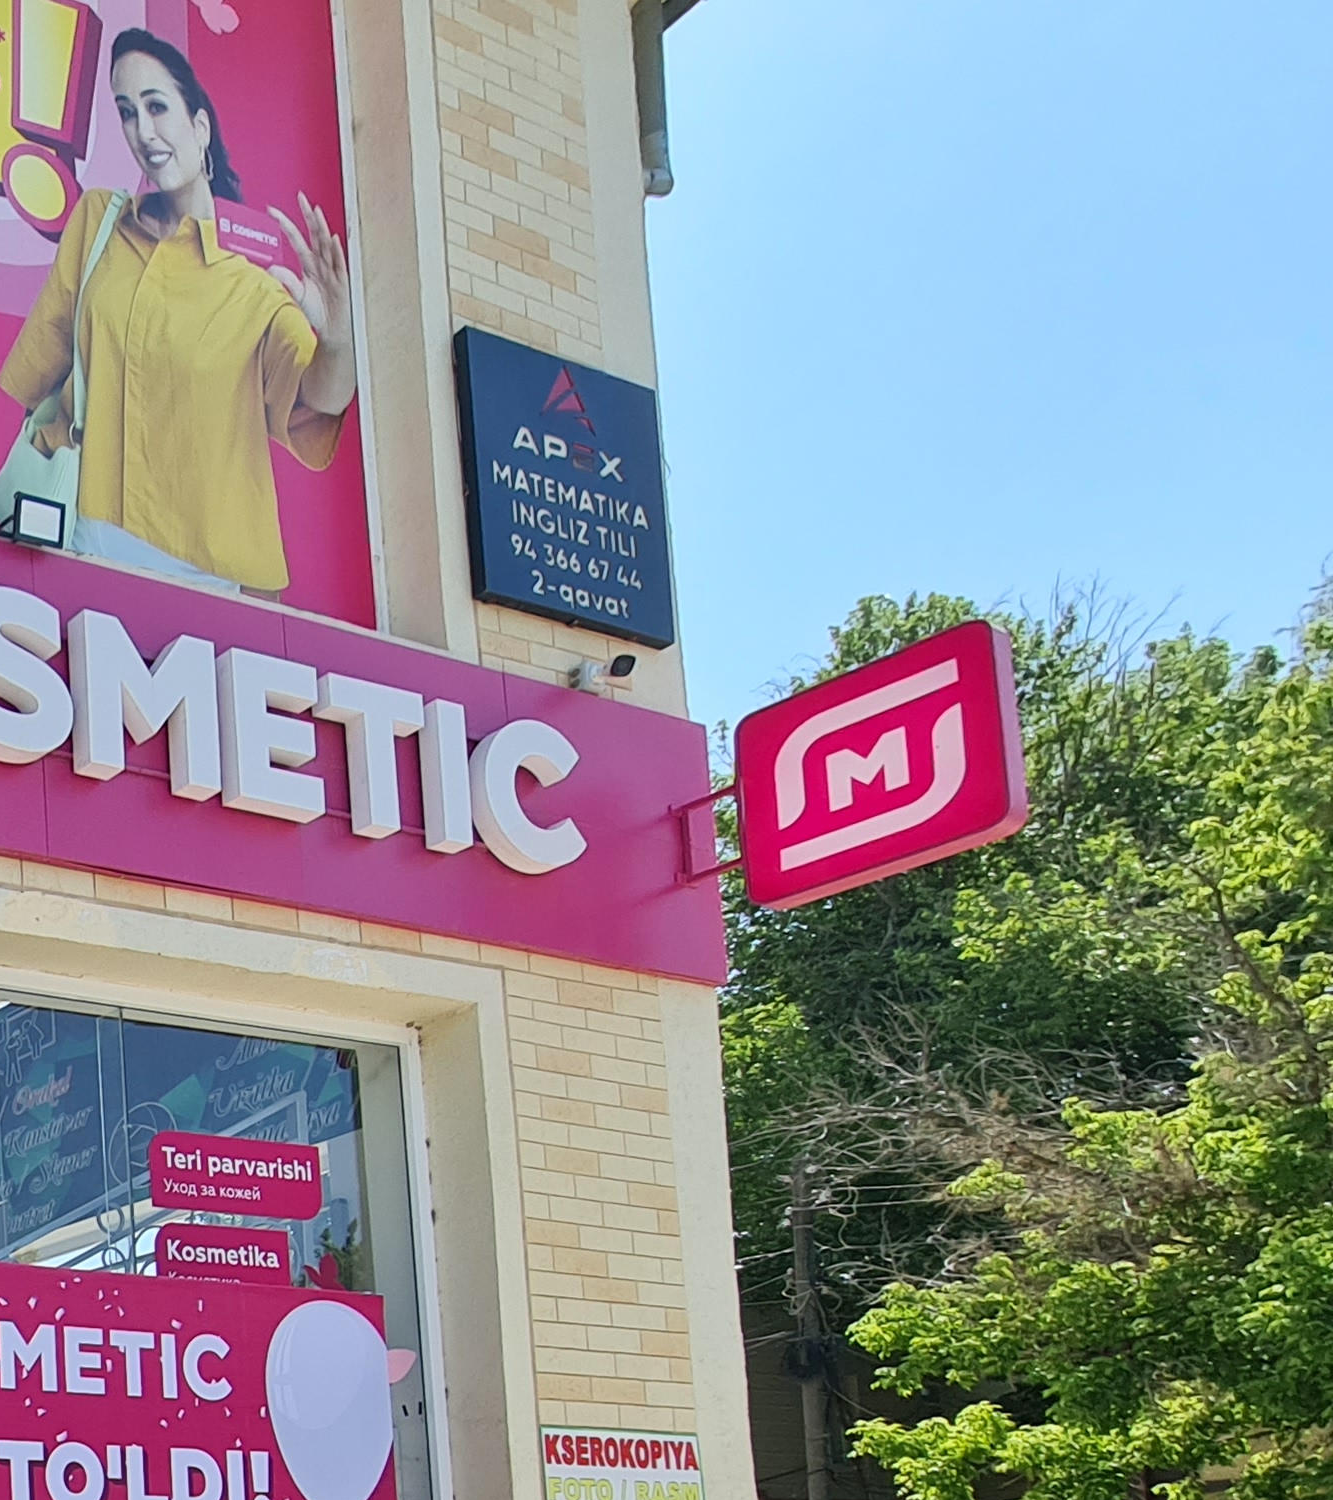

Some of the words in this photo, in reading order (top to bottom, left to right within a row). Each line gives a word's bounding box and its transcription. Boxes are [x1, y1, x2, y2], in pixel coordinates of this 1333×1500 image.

[512, 425, 624, 483] APEX
[492, 459, 649, 531] MATEMATIKA
[511, 499, 590, 546] INGLIZ
[595, 525, 637, 559] TILI
[510, 533, 538, 561] 94
[542, 543, 582, 574] 366
[587, 557, 610, 582] 67
[615, 565, 642, 590] 44
[530, 569, 630, 619] 2-qavat
[161, 1146, 202, 1171] Teri
[207, 1155, 313, 1182] parvarishi
[163, 1177, 198, 1198] Уход
[200, 1184, 216, 1197] за
[219, 1185, 261, 1201] кожей
[166, 1238, 280, 1269] Kosmetika
[544, 1433, 701, 1472] KSEROKOPIYA
